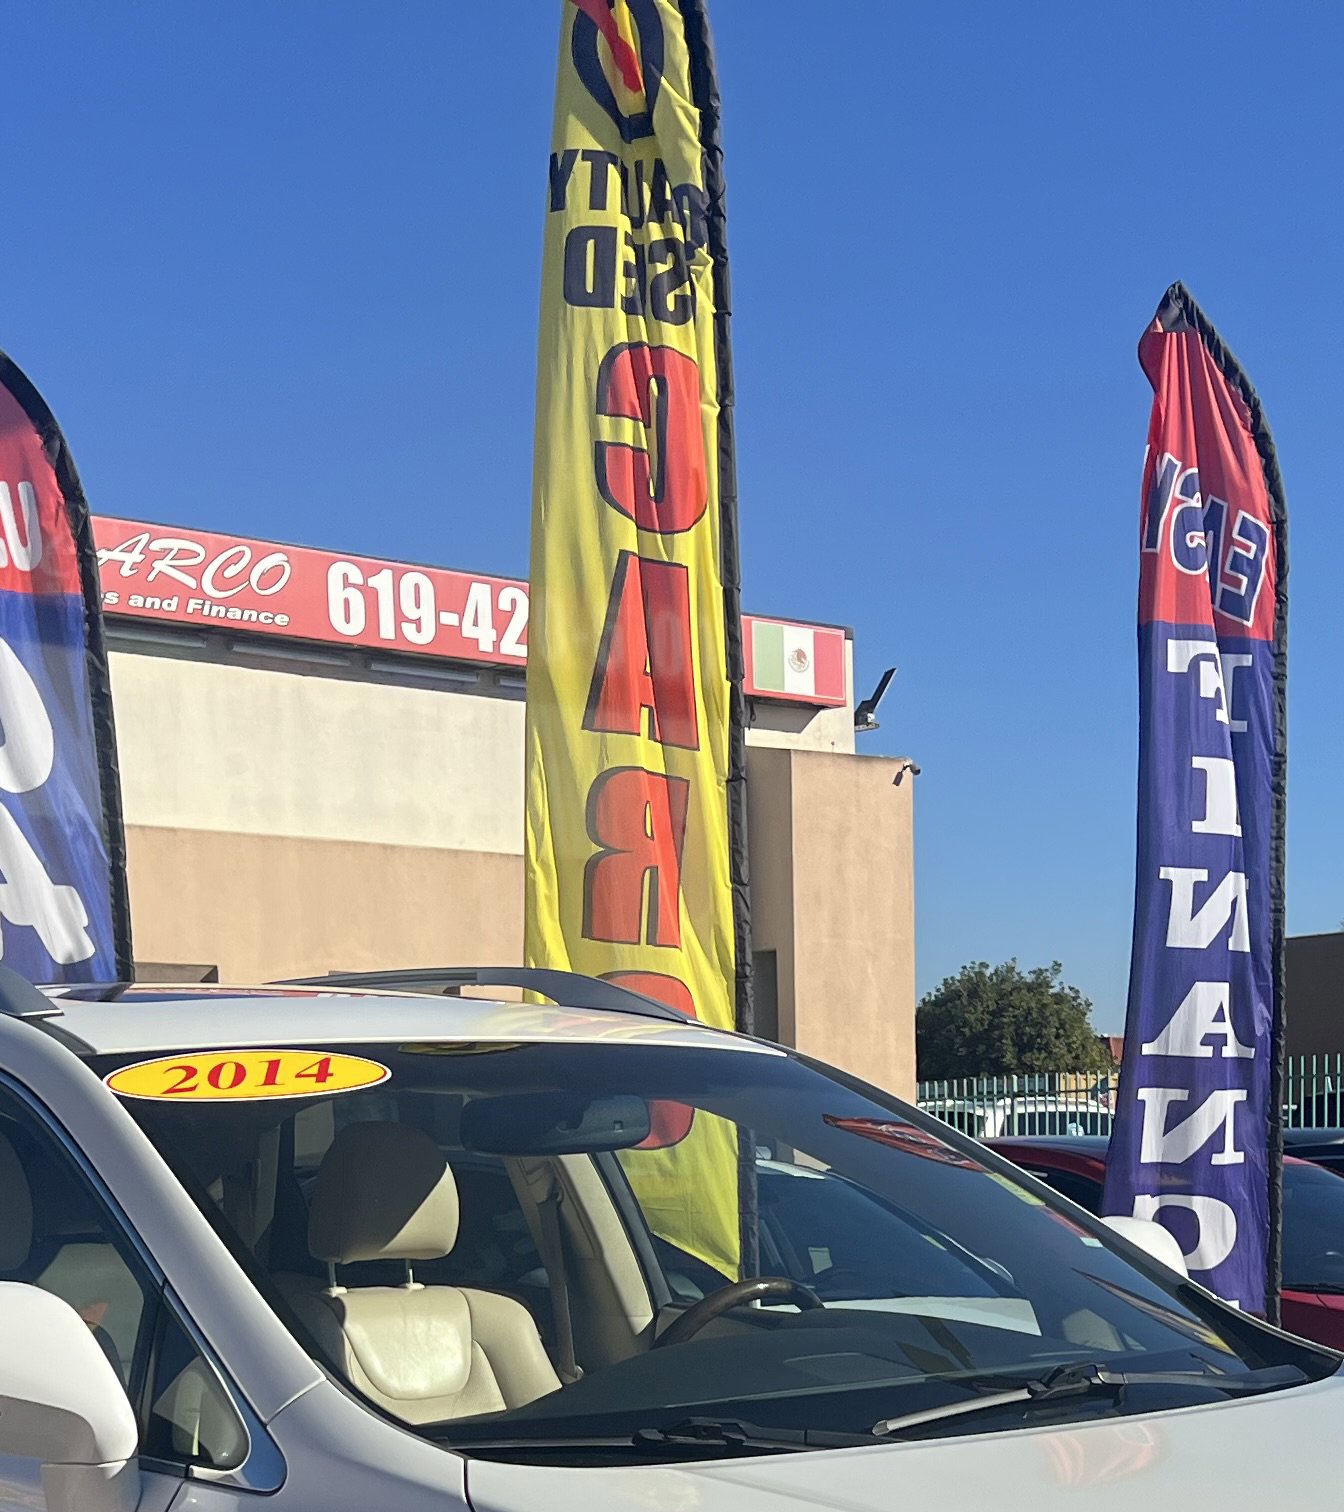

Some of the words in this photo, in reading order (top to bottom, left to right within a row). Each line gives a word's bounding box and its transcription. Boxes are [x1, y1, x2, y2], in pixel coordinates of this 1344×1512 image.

[128, 592, 178, 613] and
[186, 598, 291, 627] Finance
[160, 1056, 334, 1095] 2014
